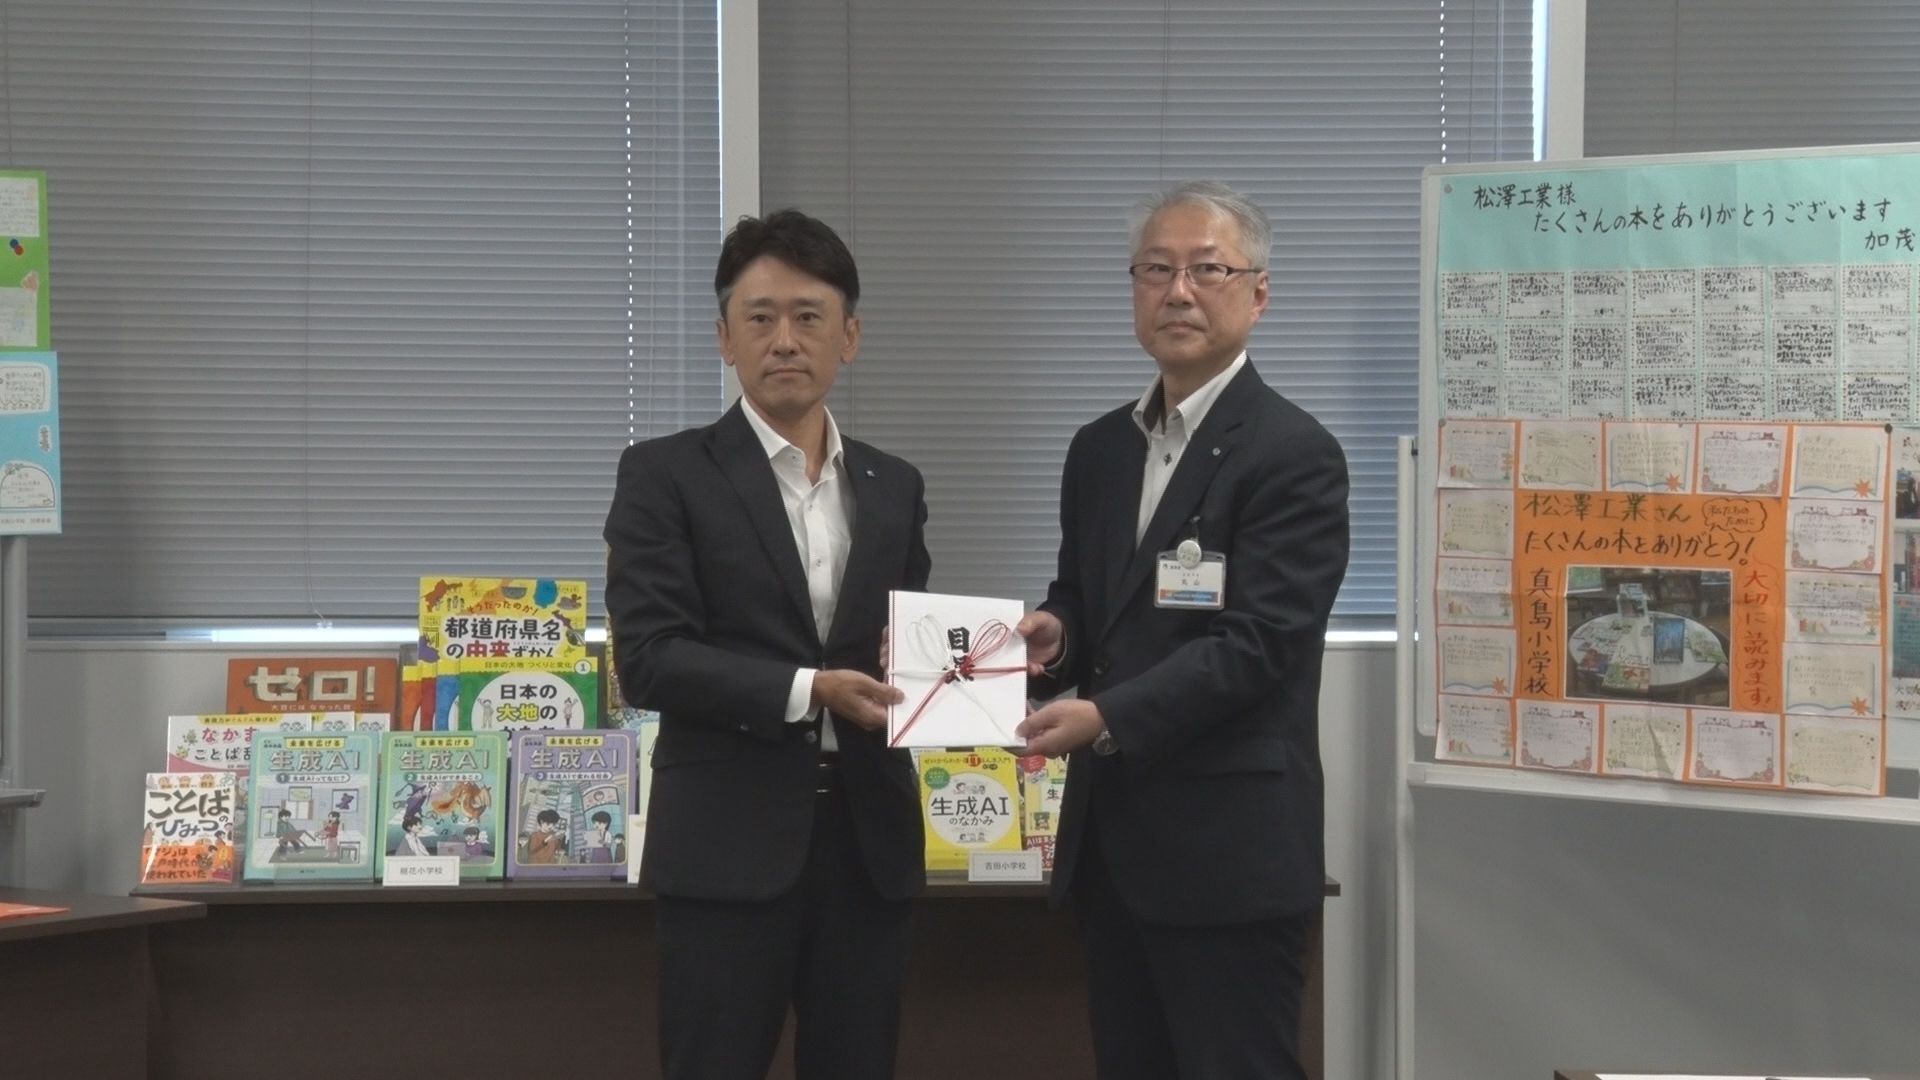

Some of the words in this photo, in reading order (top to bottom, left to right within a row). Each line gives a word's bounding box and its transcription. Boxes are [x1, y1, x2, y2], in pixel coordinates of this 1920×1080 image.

[1474, 182, 1576, 210] 松澤工業様
[1533, 197, 1892, 234] たくさんの本をありがとうございます
[1865, 227, 1916, 252] 加茂
[1523, 493, 1692, 521] 松澤工業さん
[444, 616, 561, 640] 都道府県名
[1524, 567, 1552, 695] 真島小学校
[580, 663, 587, 671] 1
[247, 666, 376, 701] ゼロ!
[500, 684, 558, 700] 日本の
[495, 703, 558, 722] 大地の
[270, 751, 361, 772] 生成AI
[400, 750, 490, 771] 生成AI
[530, 749, 619, 769] 生成AI
[147, 788, 231, 820] ことば
[931, 797, 1010, 816] 生成AI
[155, 819, 221, 838] ひみつ
[219, 815, 229, 823] の
[949, 816, 994, 826] のなかみ
